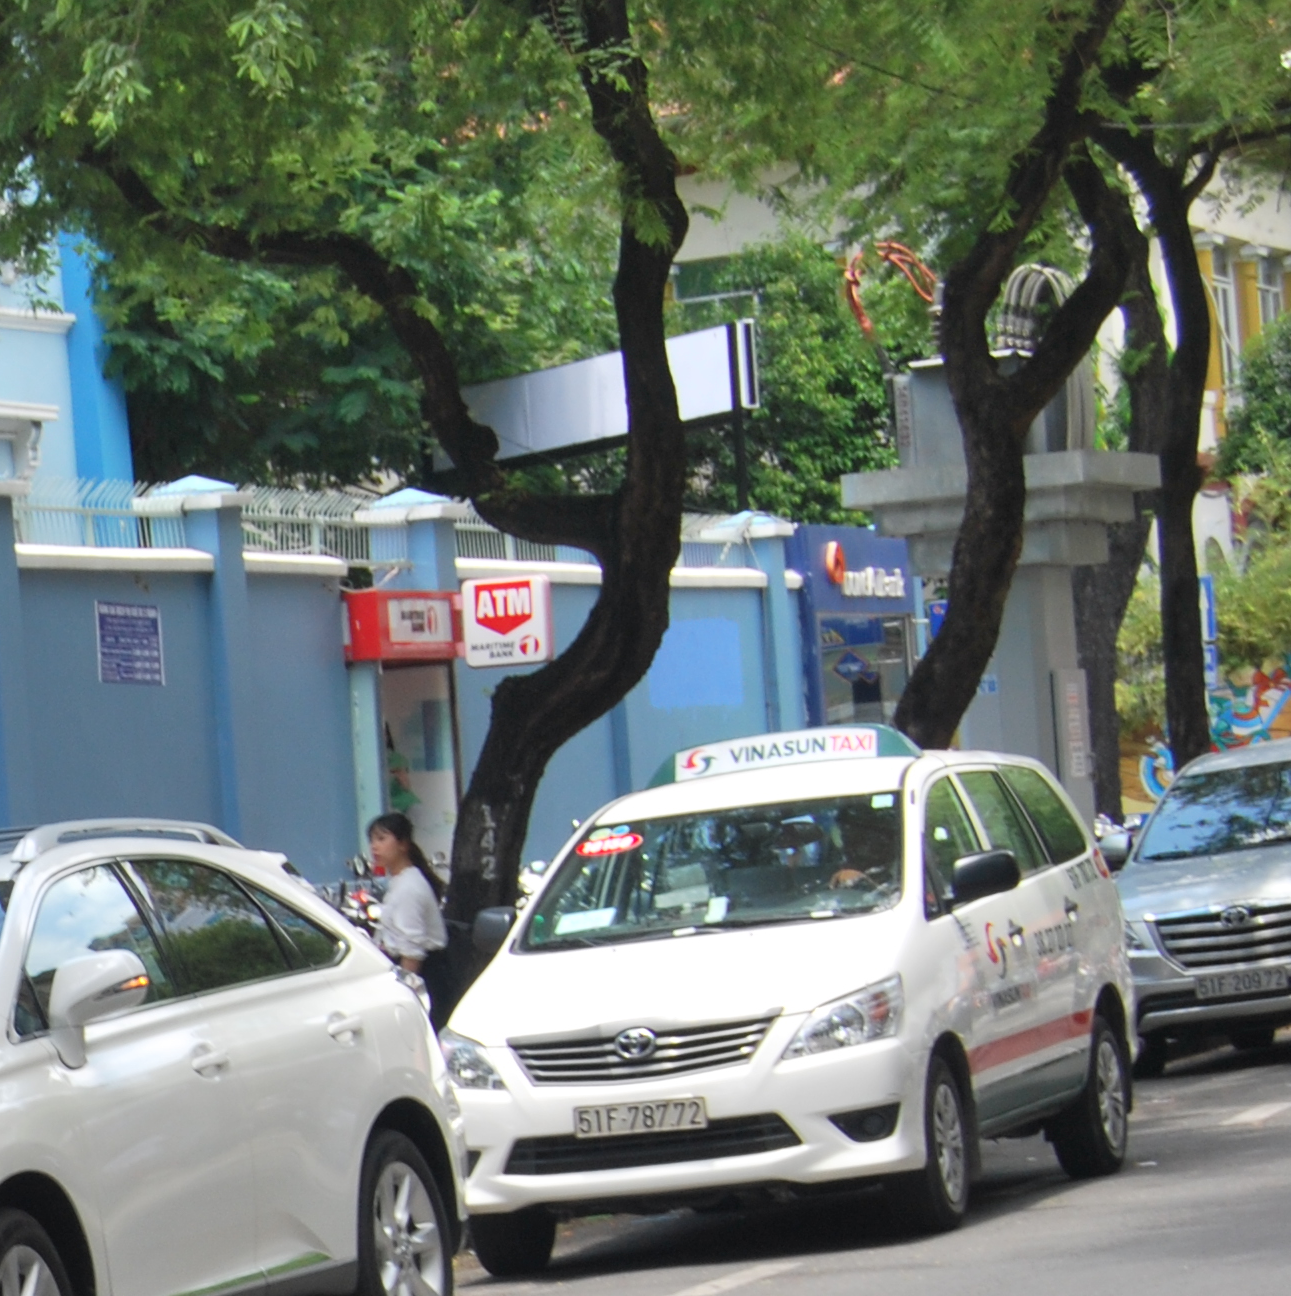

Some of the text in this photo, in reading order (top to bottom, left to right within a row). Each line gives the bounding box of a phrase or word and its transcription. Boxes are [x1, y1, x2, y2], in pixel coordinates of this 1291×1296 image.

[476, 587, 532, 619] ATM
[470, 640, 516, 652] MARITIME
[488, 649, 515, 659] BANK
[729, 733, 875, 764] VINASUN TAXI
[578, 1100, 702, 1134] 51F-787.72
